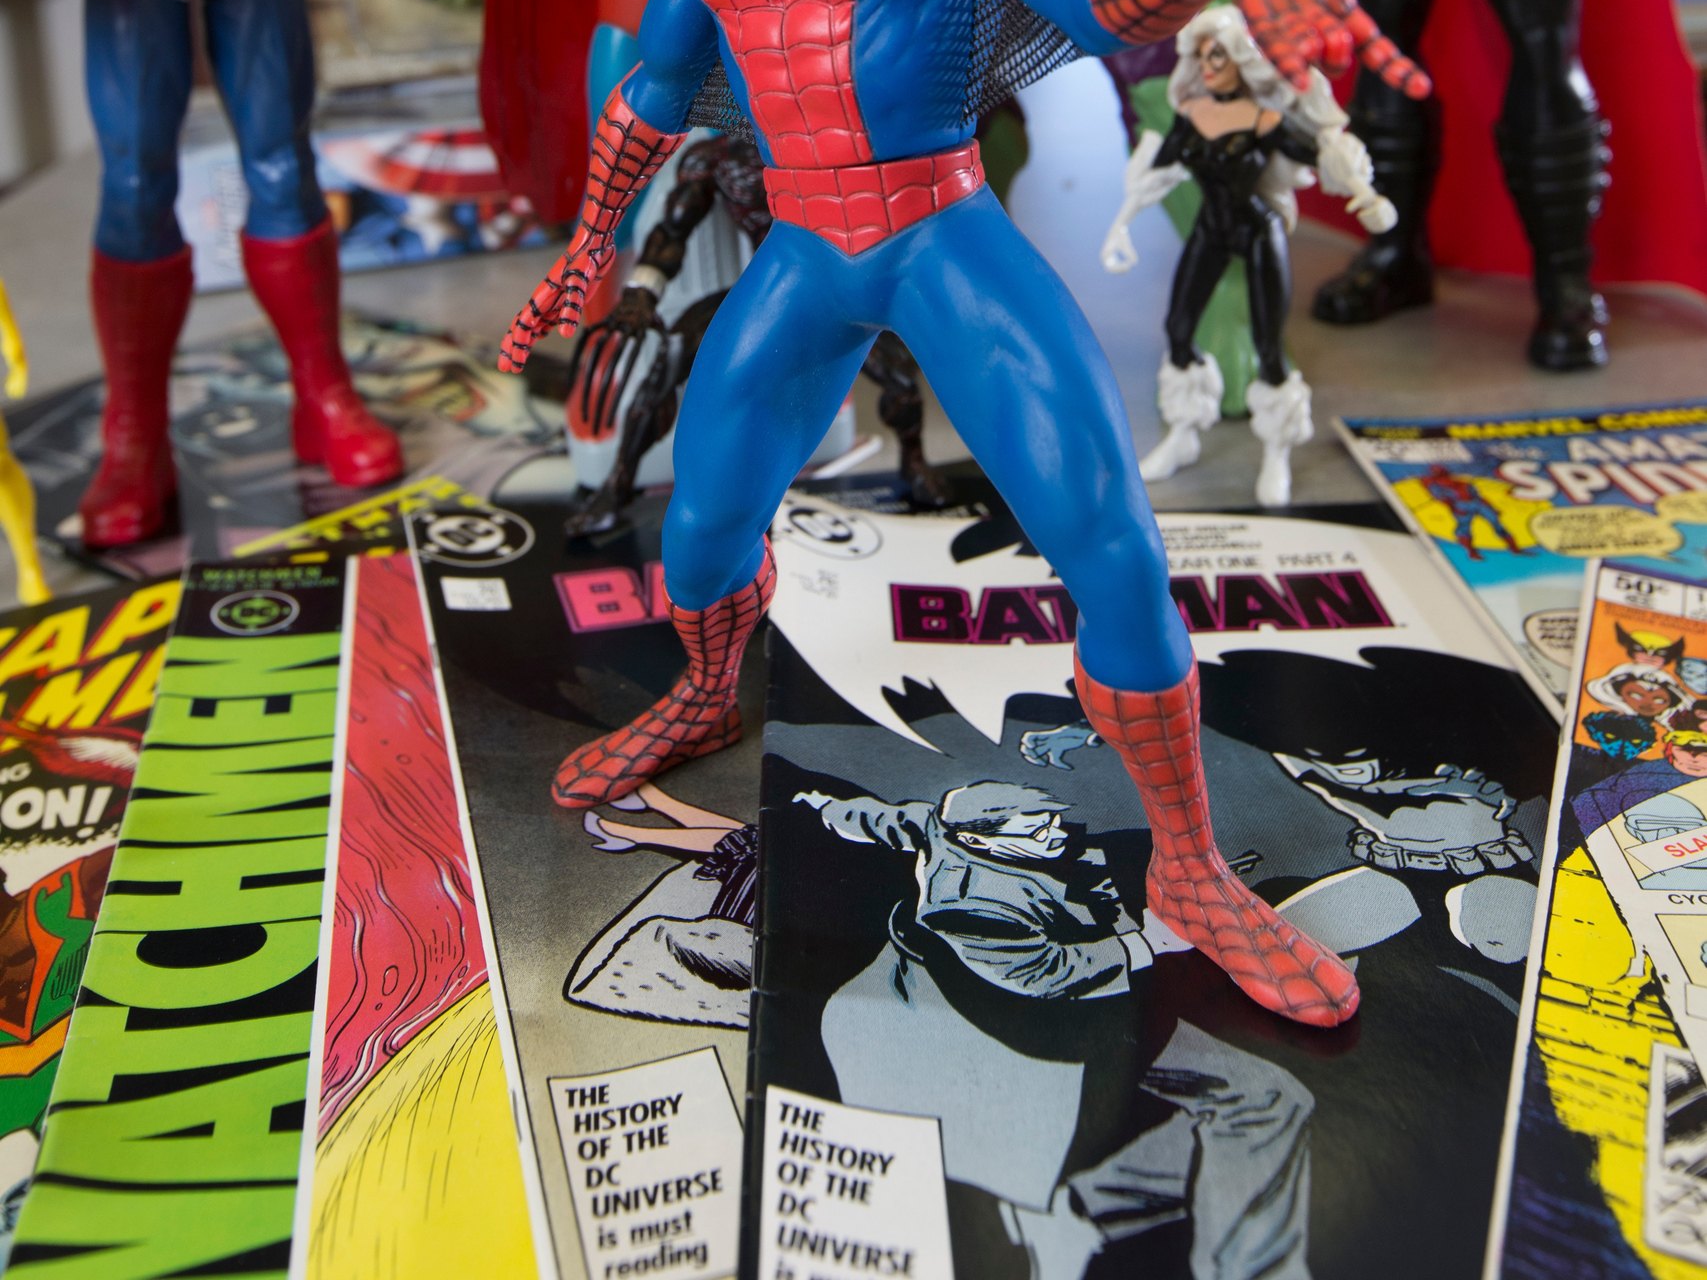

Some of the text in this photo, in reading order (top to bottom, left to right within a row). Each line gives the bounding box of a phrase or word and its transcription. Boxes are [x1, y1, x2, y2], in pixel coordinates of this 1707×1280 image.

[1568, 431, 1707, 462] AMA
[1167, 554, 1214, 569] EAR
[1276, 552, 1335, 567] PART
[0, 783, 113, 839] ON!
[1663, 834, 1707, 859] SLA
[565, 1083, 610, 1109] THE
[573, 1092, 683, 1134] HISTORY
[779, 1100, 824, 1133] THE
[577, 1124, 669, 1160] OF THE
[779, 1130, 896, 1176] HISTORY
[585, 1162, 621, 1189] DC
[592, 1167, 723, 1219] UNIVERSE
[777, 1160, 872, 1204] OF THE
[777, 1191, 816, 1223] DC
[599, 1208, 693, 1248] is must
[604, 1241, 708, 1280] reading
[777, 1223, 915, 1277] UNIVERSE
